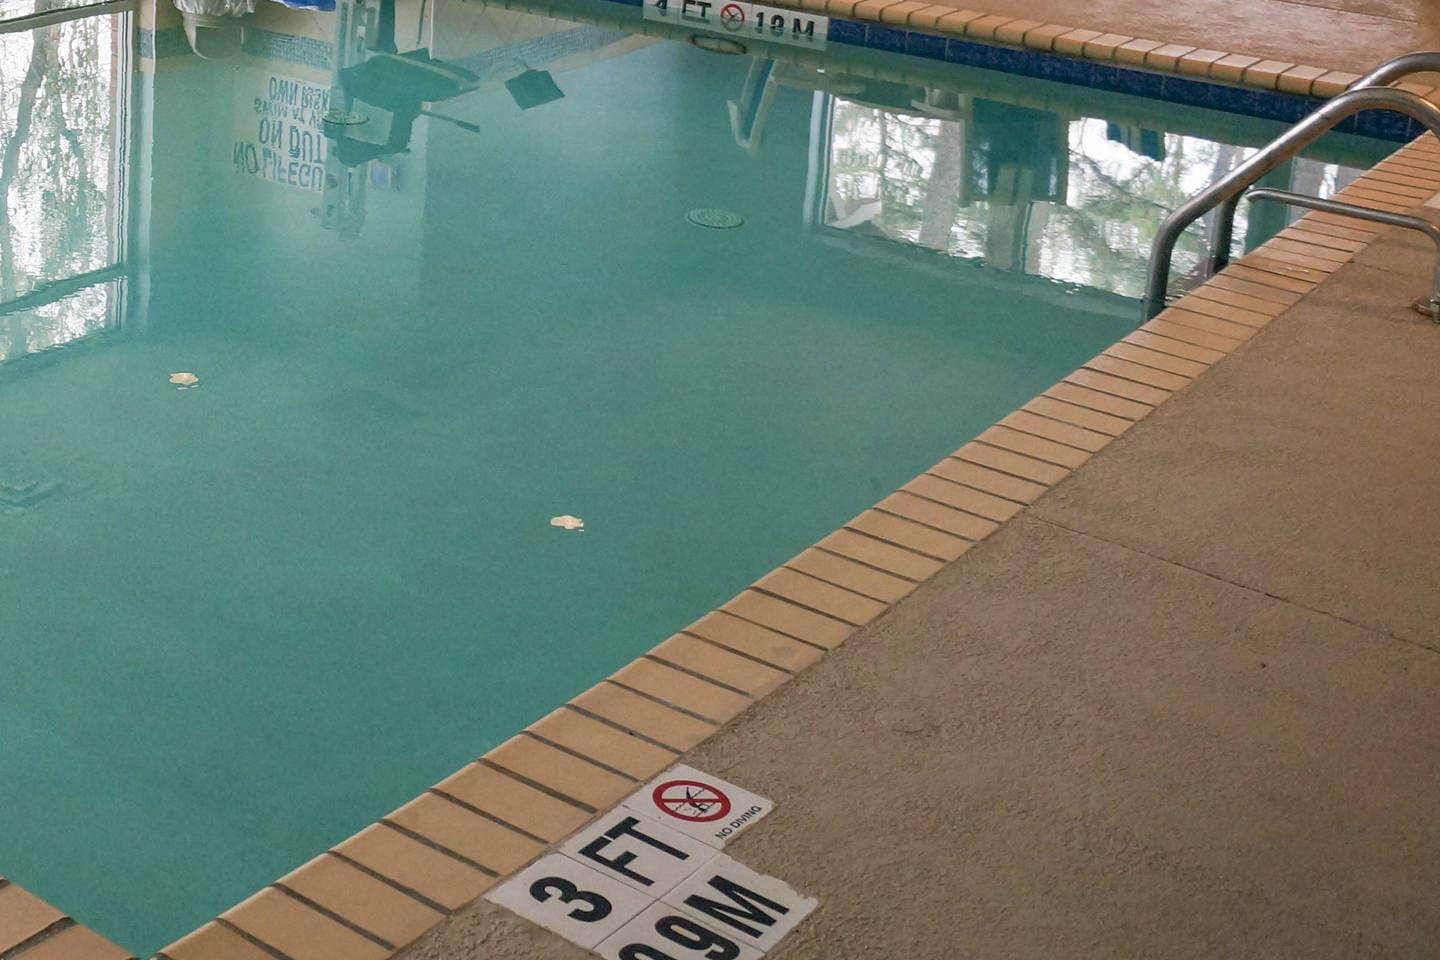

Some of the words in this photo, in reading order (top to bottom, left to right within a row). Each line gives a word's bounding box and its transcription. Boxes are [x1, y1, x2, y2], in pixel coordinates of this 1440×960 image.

[715, 827, 733, 840] NO
[729, 805, 763, 829] DIVING
[529, 876, 613, 923] 3
[578, 815, 691, 887] FT
